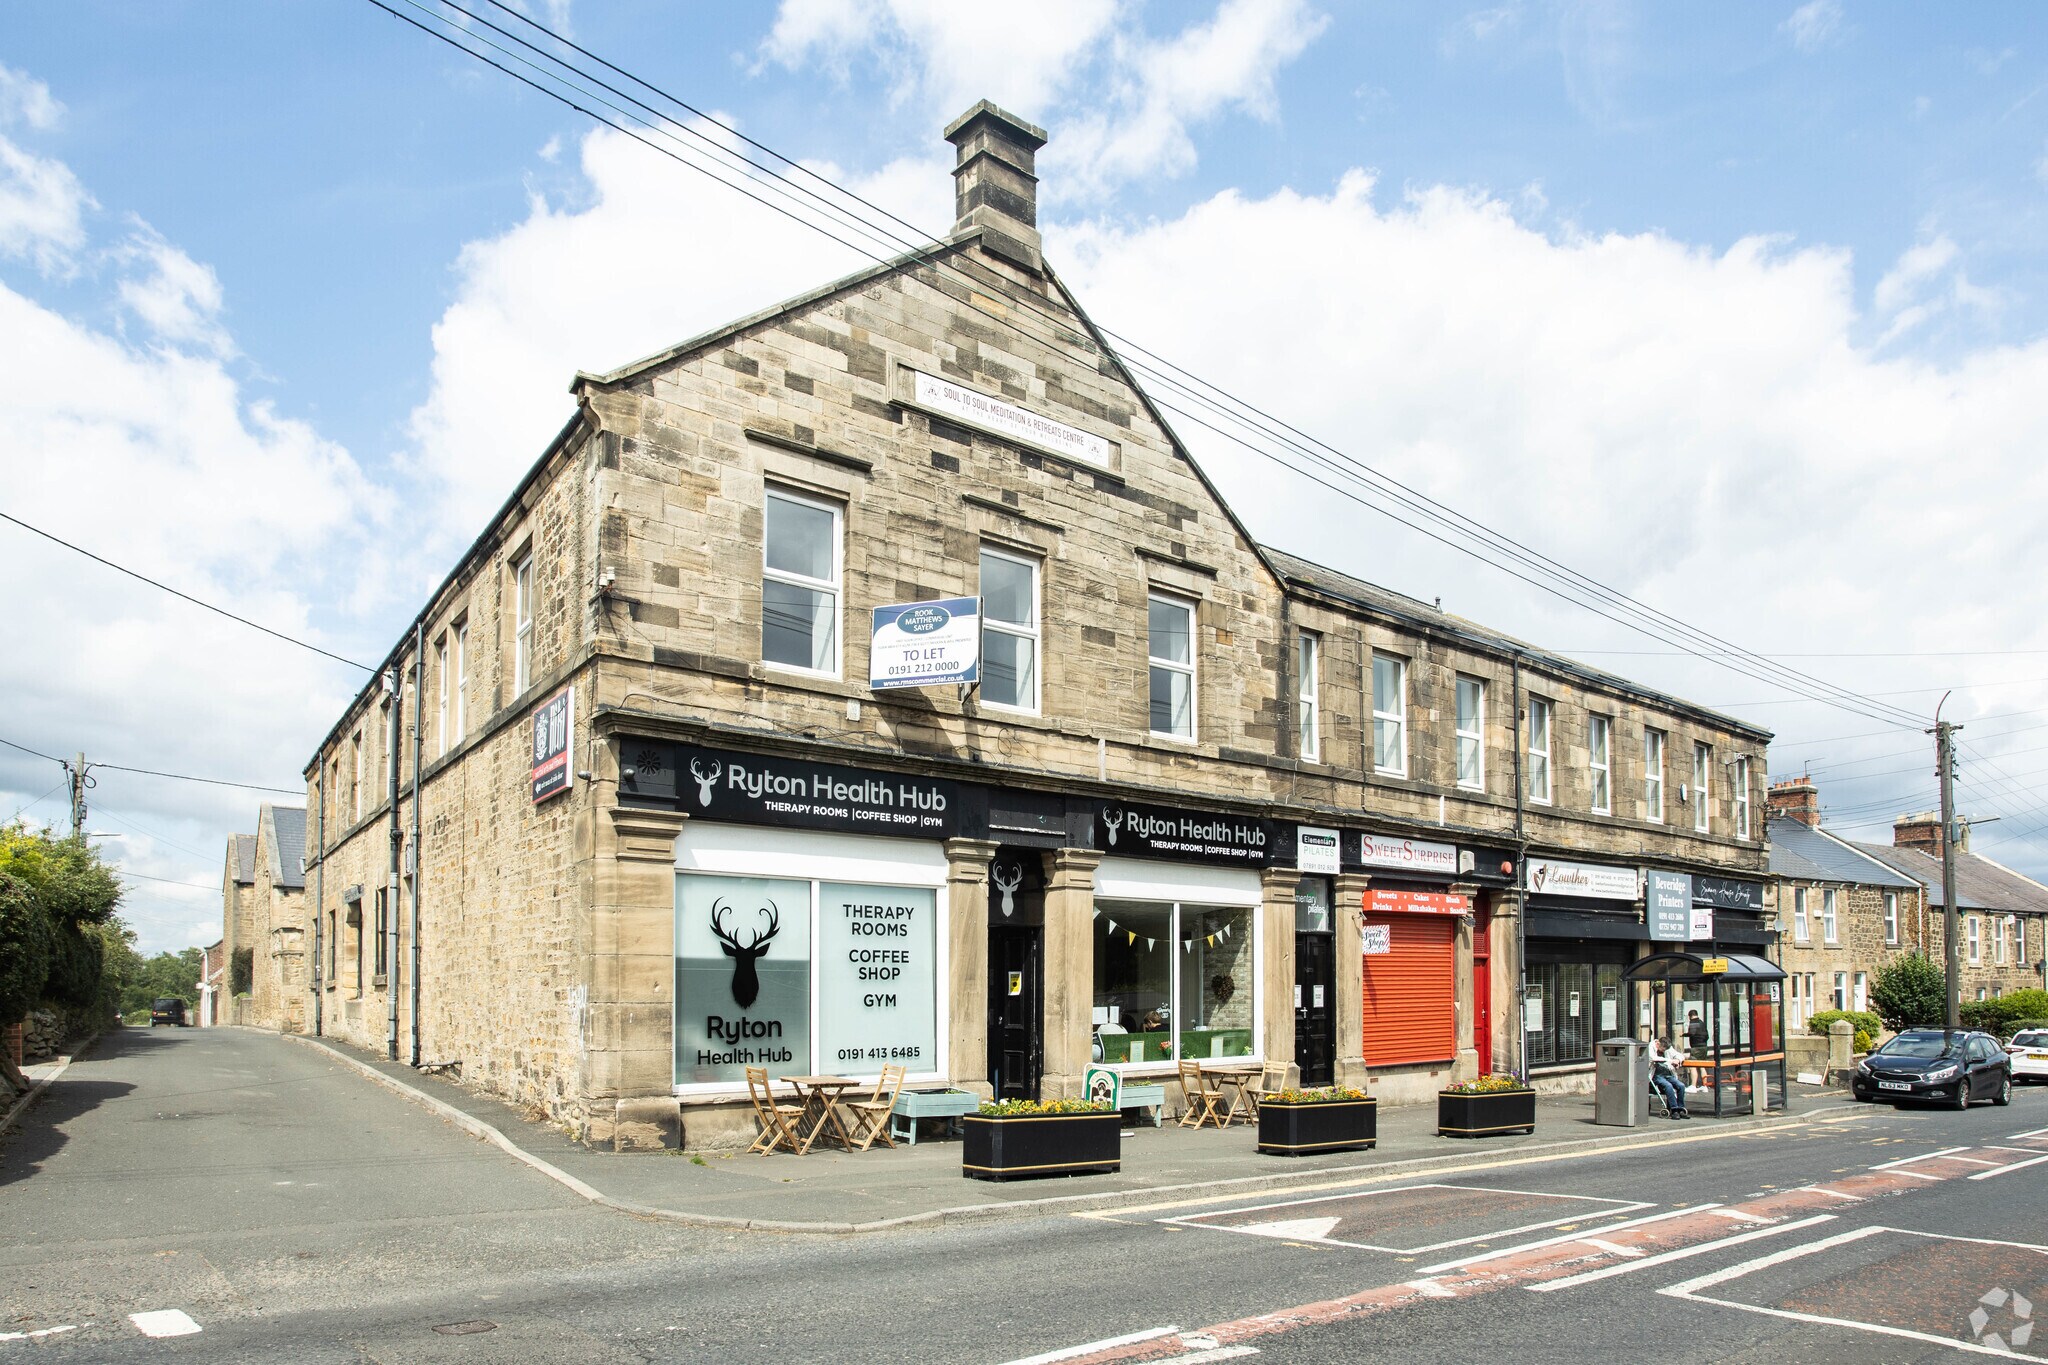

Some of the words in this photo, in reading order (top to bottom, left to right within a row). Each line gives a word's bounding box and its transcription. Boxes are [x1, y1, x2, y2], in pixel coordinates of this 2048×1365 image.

[943, 387, 961, 403] SOUL
[962, 393, 971, 406] TO
[972, 396, 989, 412] SOUL
[990, 404, 1026, 425] MEDITATION
[1026, 416, 1032, 426] &
[1033, 419, 1062, 438] RETREATS
[1062, 428, 1084, 446] CENTRE
[905, 615, 943, 625] MATTHEWS
[914, 608, 934, 617] ROOK
[913, 623, 934, 632] SAYER
[903, 649, 919, 661] TO
[924, 647, 945, 660] LET
[888, 665, 912, 676] 0191
[914, 663, 932, 673] 212
[935, 661, 959, 671] 0000
[883, 674, 965, 687] www.rmscommercial.co.uk
[728, 764, 806, 799] Ryton
[813, 774, 893, 806] Health
[899, 784, 947, 811] Hub
[764, 800, 811, 814] THERAPY
[813, 805, 849, 818] ROOMS
[893, 813, 918, 825] SHOP
[1127, 811, 1177, 839] Ryton
[1180, 818, 1232, 843] Health
[1235, 824, 1266, 846] Hub
[1150, 839, 1179, 850] THERAPY
[1180, 843, 1203, 853] ROOMS
[1231, 848, 1248, 857] SHOP
[1303, 835, 1334, 847] Elementary
[1303, 845, 1335, 857] PILATES
[1547, 864, 1589, 886] Lowther
[1655, 876, 1686, 895] Beveridge
[1377, 891, 1398, 900] Sweets
[1413, 893, 1430, 902] Cakes
[1658, 893, 1684, 908] Printers
[843, 904, 915, 920] THERAPY
[1372, 902, 1392, 911] Drinks
[1407, 904, 1437, 912] Milkshakes
[851, 922, 908, 937] ROOMS
[849, 949, 910, 964] COFFEE
[858, 967, 901, 981] SHOP
[863, 994, 897, 1007] GYM
[707, 1015, 782, 1045] Ryton
[697, 1048, 754, 1065] Health
[758, 1046, 792, 1063] Hub
[838, 1048, 864, 1060] 0191
[868, 1047, 887, 1059] 413
[891, 1046, 920, 1058] 6485
